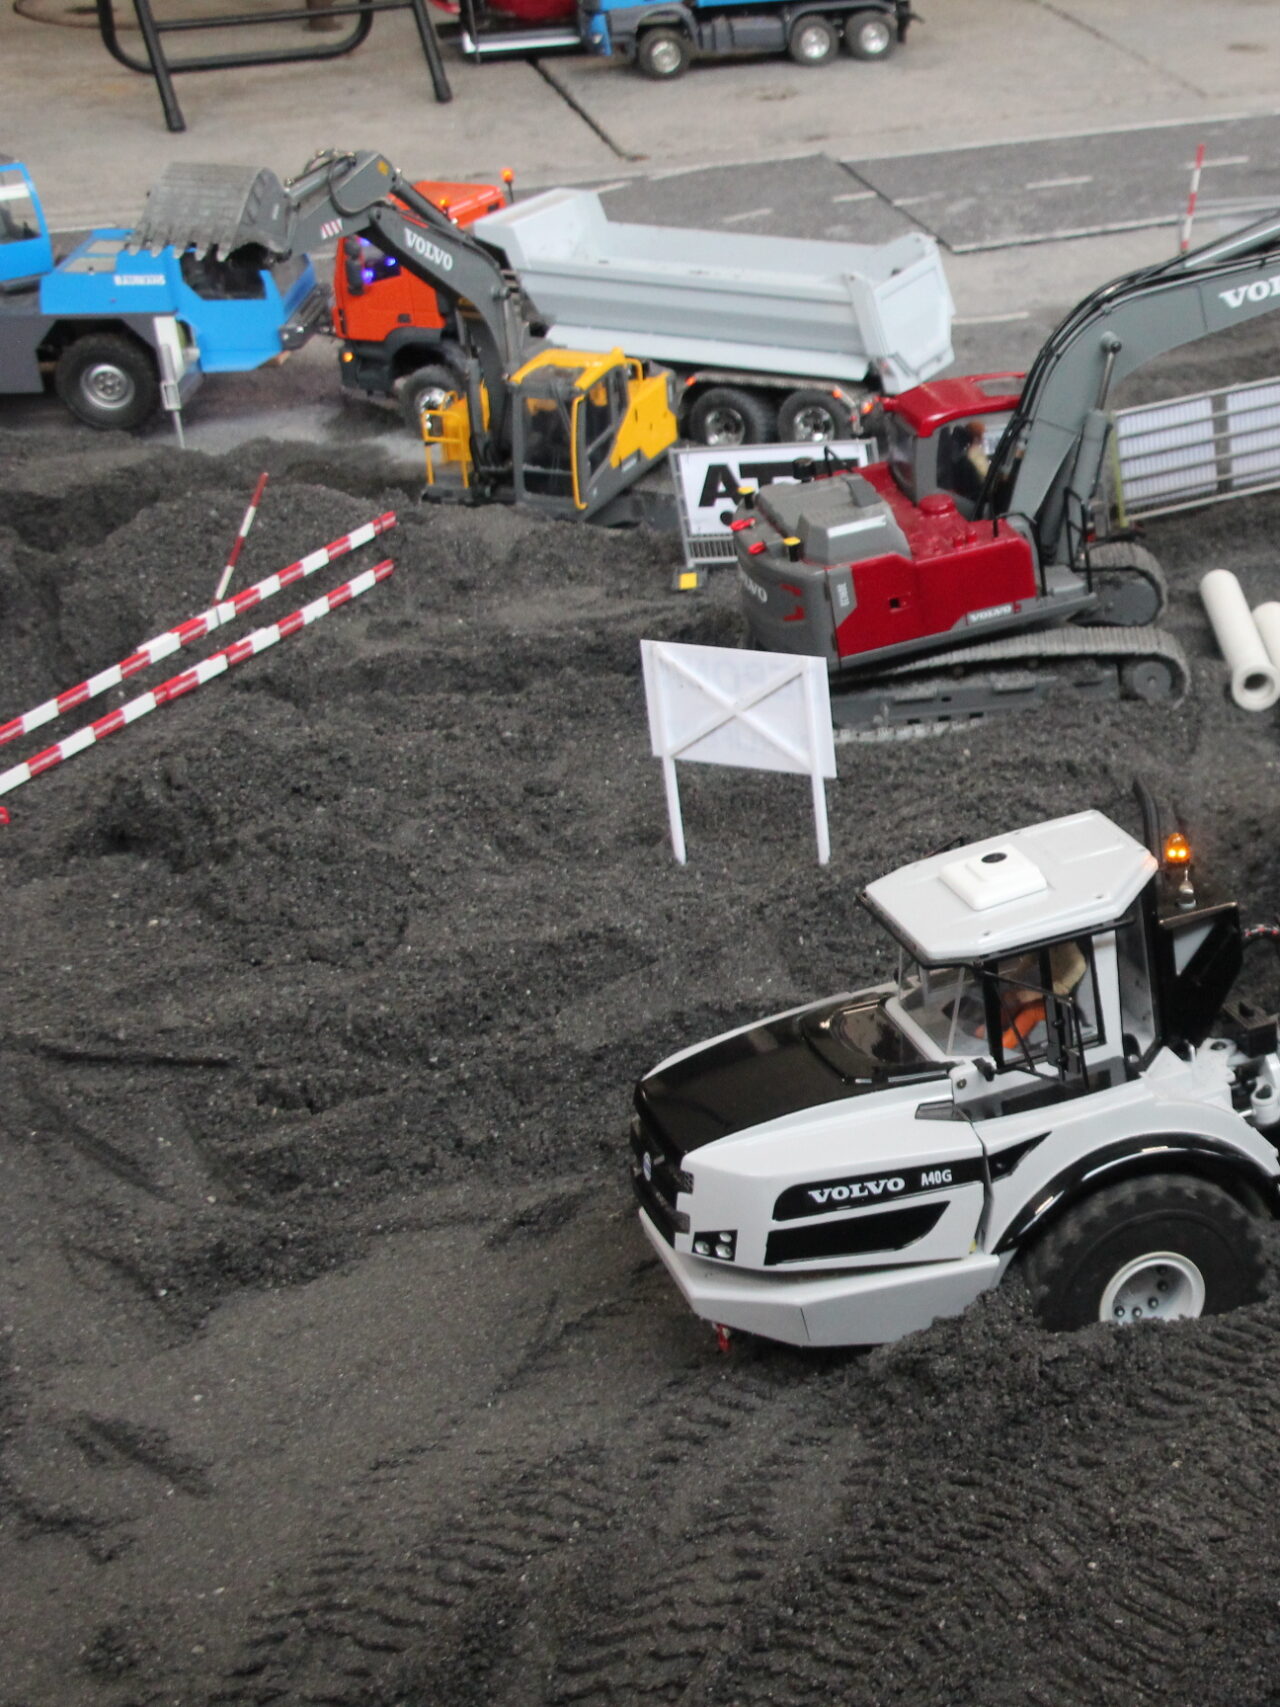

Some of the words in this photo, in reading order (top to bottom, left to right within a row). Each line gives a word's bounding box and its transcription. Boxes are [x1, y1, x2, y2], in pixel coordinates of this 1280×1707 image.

[404, 227, 453, 271] VOLVO
[808, 1177, 905, 1204] VOLVO
[921, 1169, 952, 1187] A40G
